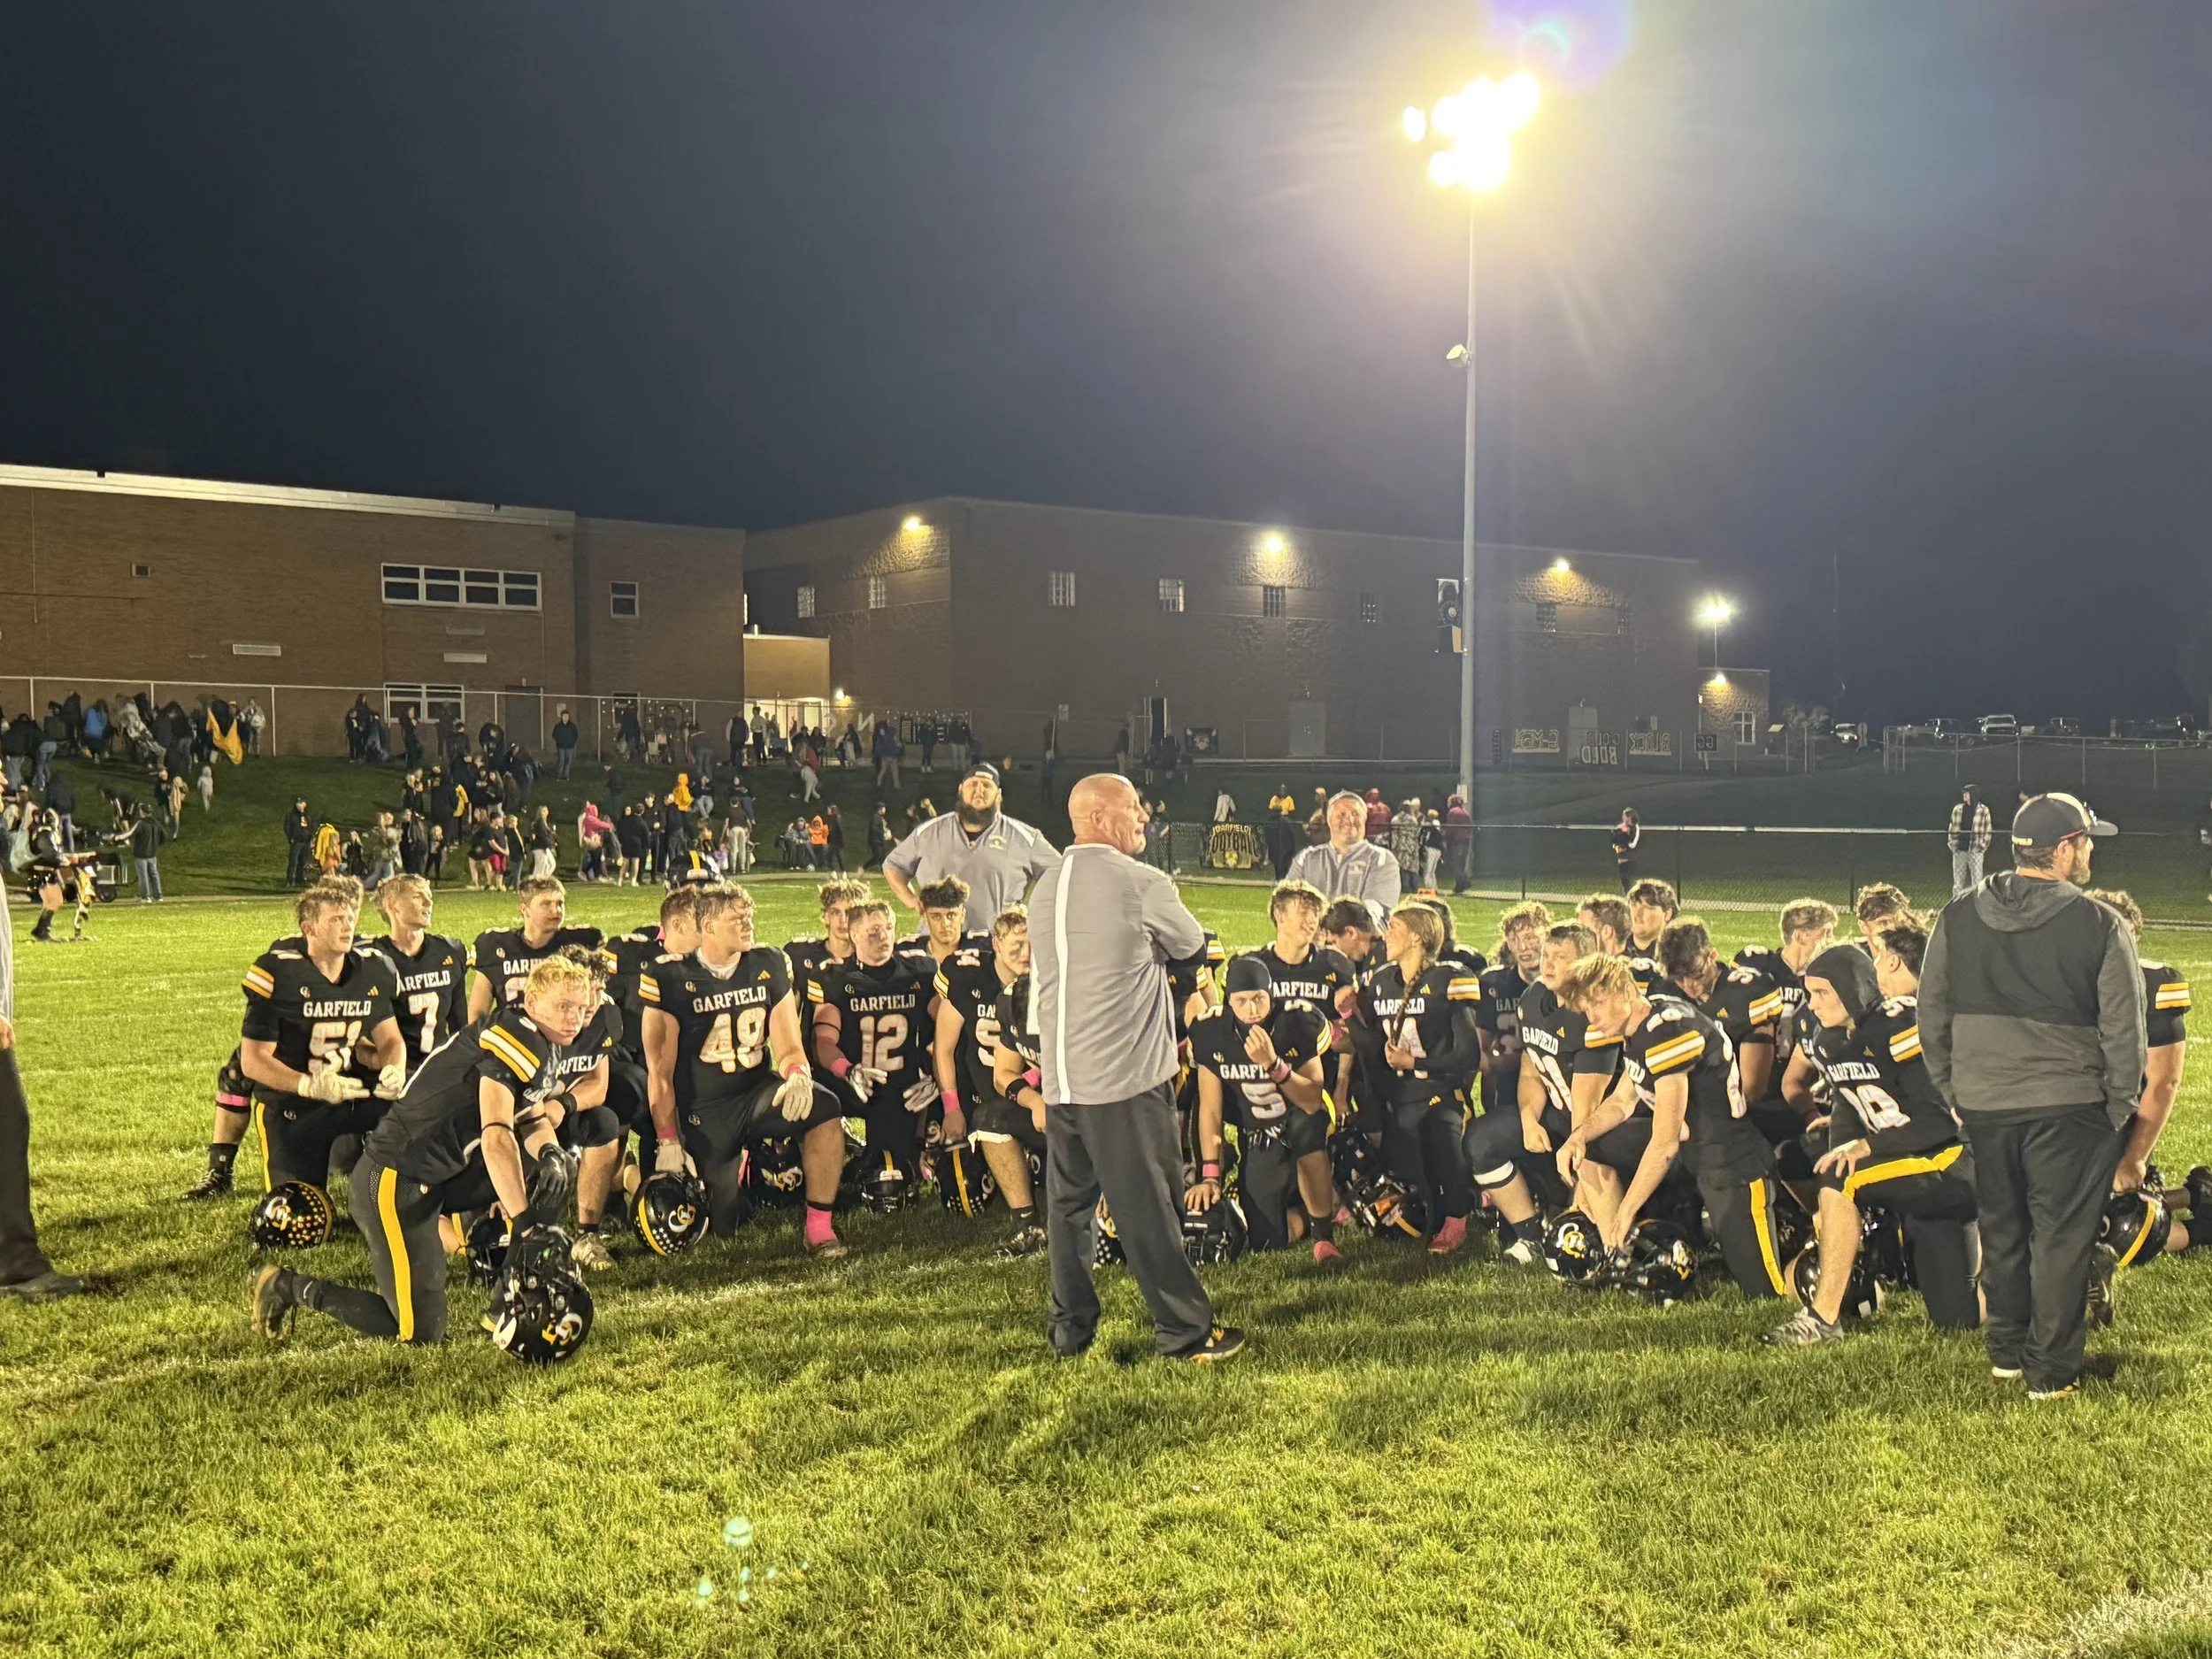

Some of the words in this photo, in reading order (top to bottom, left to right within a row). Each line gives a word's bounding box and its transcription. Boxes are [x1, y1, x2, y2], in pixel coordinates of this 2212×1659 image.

[692, 985, 767, 1014] GARFIELD
[849, 994, 916, 1012] GARFIELD
[1273, 981, 1329, 1000] ARFIELD
[303, 1000, 372, 1018] GARFIELD
[408, 991, 440, 1054] 7
[699, 1006, 767, 1073] 49
[859, 1013, 909, 1073] 12
[1522, 1025, 1559, 1056] GARFIELD
[1827, 1062, 1881, 1083] GARFIELD
[1240, 1082, 1286, 1119] 5
